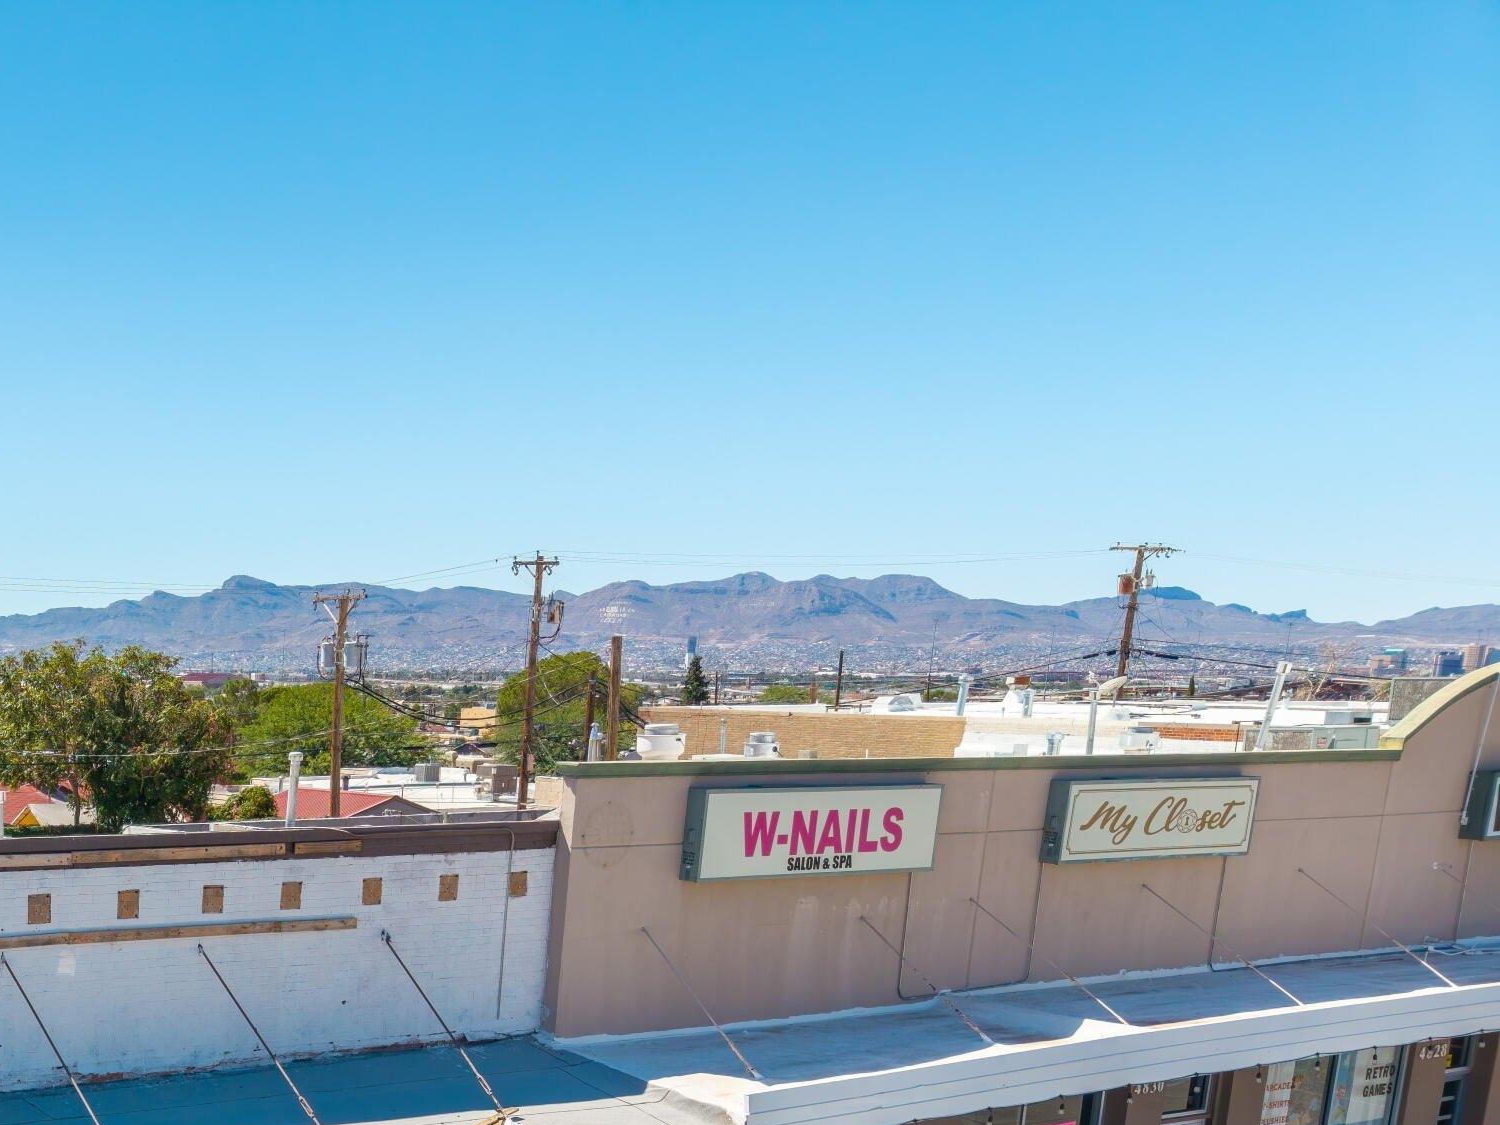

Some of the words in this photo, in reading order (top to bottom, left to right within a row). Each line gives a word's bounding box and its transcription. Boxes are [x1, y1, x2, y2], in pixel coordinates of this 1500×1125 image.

[1079, 800, 1138, 845] My
[743, 807, 904, 857] W-NAILS
[787, 856, 821, 871] SALON
[822, 858, 831, 869] &
[832, 855, 852, 868] SPA
[1365, 1065, 1396, 1080] RETRO
[1362, 1082, 1393, 1098] GAMES
